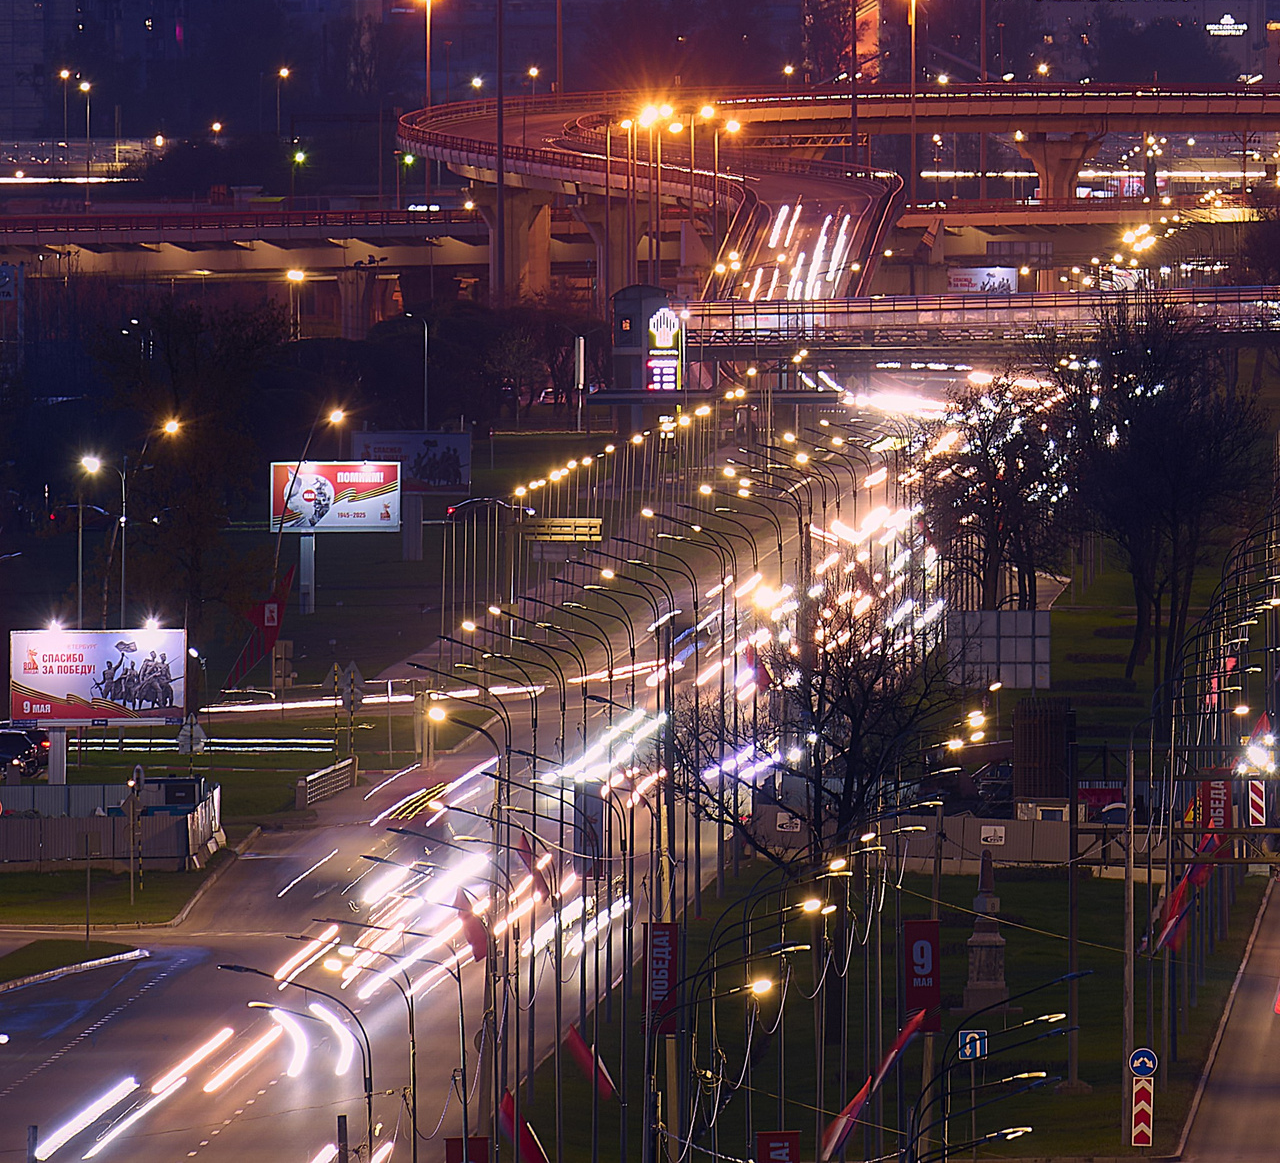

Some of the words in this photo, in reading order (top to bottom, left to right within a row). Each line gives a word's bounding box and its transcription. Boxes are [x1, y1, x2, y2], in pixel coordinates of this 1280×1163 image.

[336, 471, 385, 484] ПОМНИМ!
[42, 653, 84, 663] СПАСИБО
[42, 665, 54, 675] ЗА
[57, 664, 96, 675] ПОБЕДУ!
[23, 701, 31, 714] 9
[32, 704, 51, 713] МАЯ
[912, 939, 933, 976] 9
[652, 930, 672, 1001] ПОБЕДА!
[913, 977, 933, 987] МАЯ
